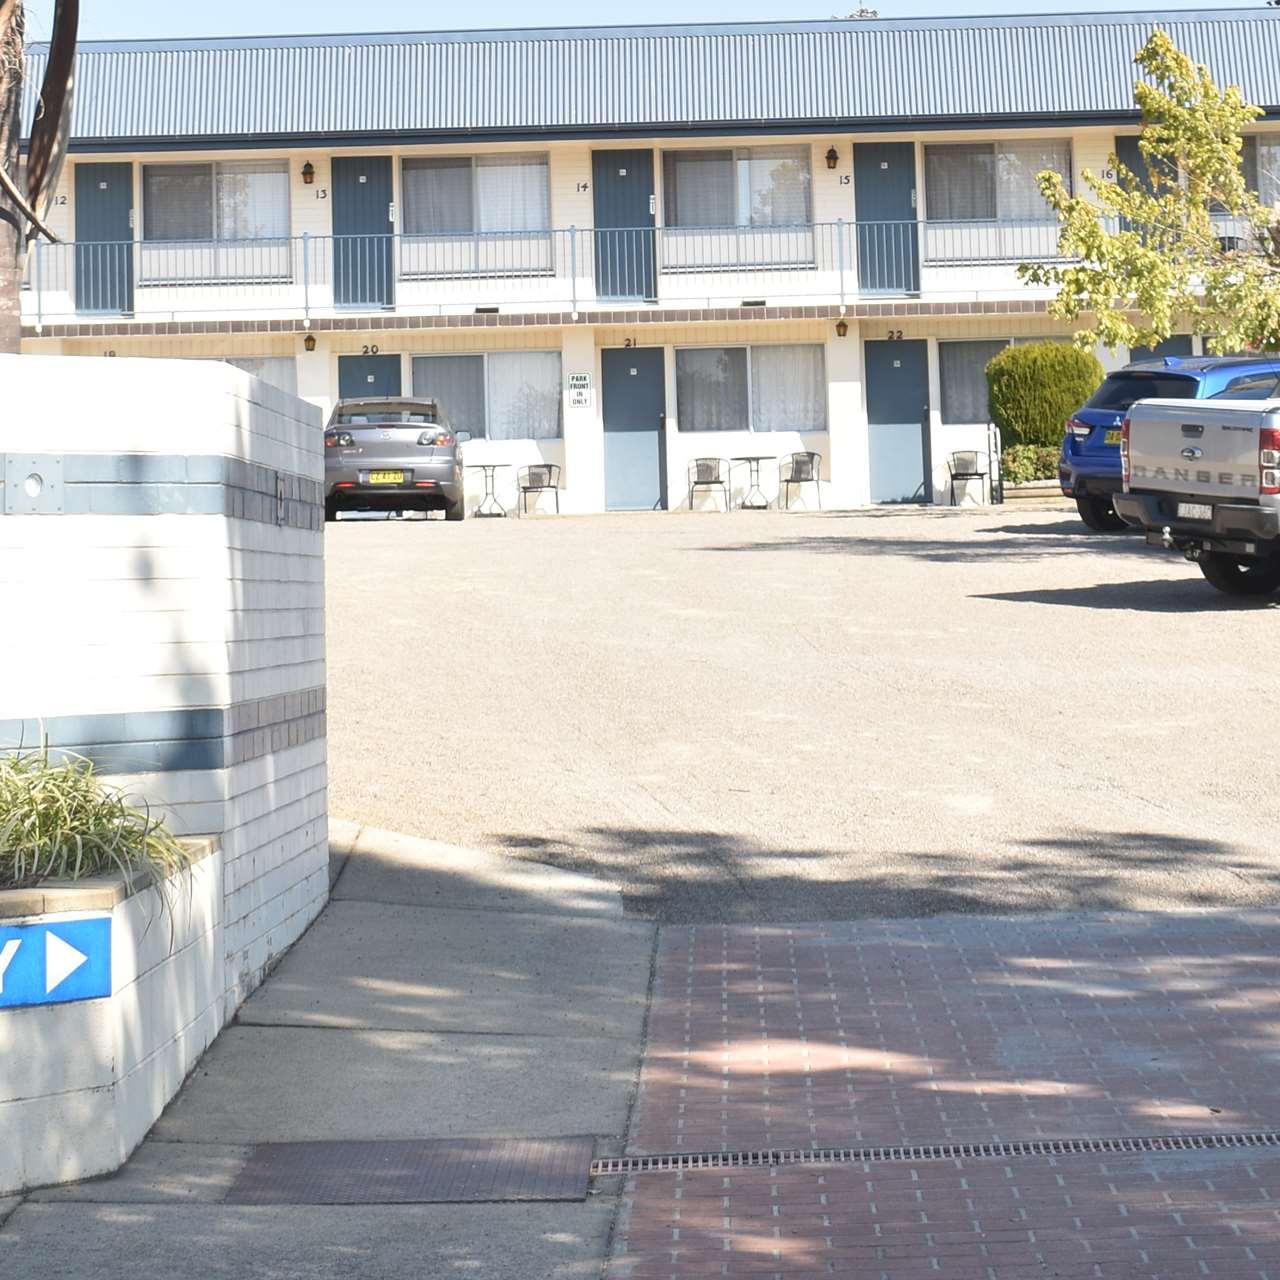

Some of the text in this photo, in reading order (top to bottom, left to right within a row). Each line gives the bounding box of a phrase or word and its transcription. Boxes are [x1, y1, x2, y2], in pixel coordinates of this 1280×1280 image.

[1102, 170, 1113, 179] 16
[840, 175, 850, 185] 15
[577, 182, 589, 192] 14
[55, 195, 67, 205] 12
[888, 330, 903, 340] 22
[624, 337, 637, 347] 21
[362, 344, 379, 354] 20
[1132, 465, 1257, 487] RANGER
